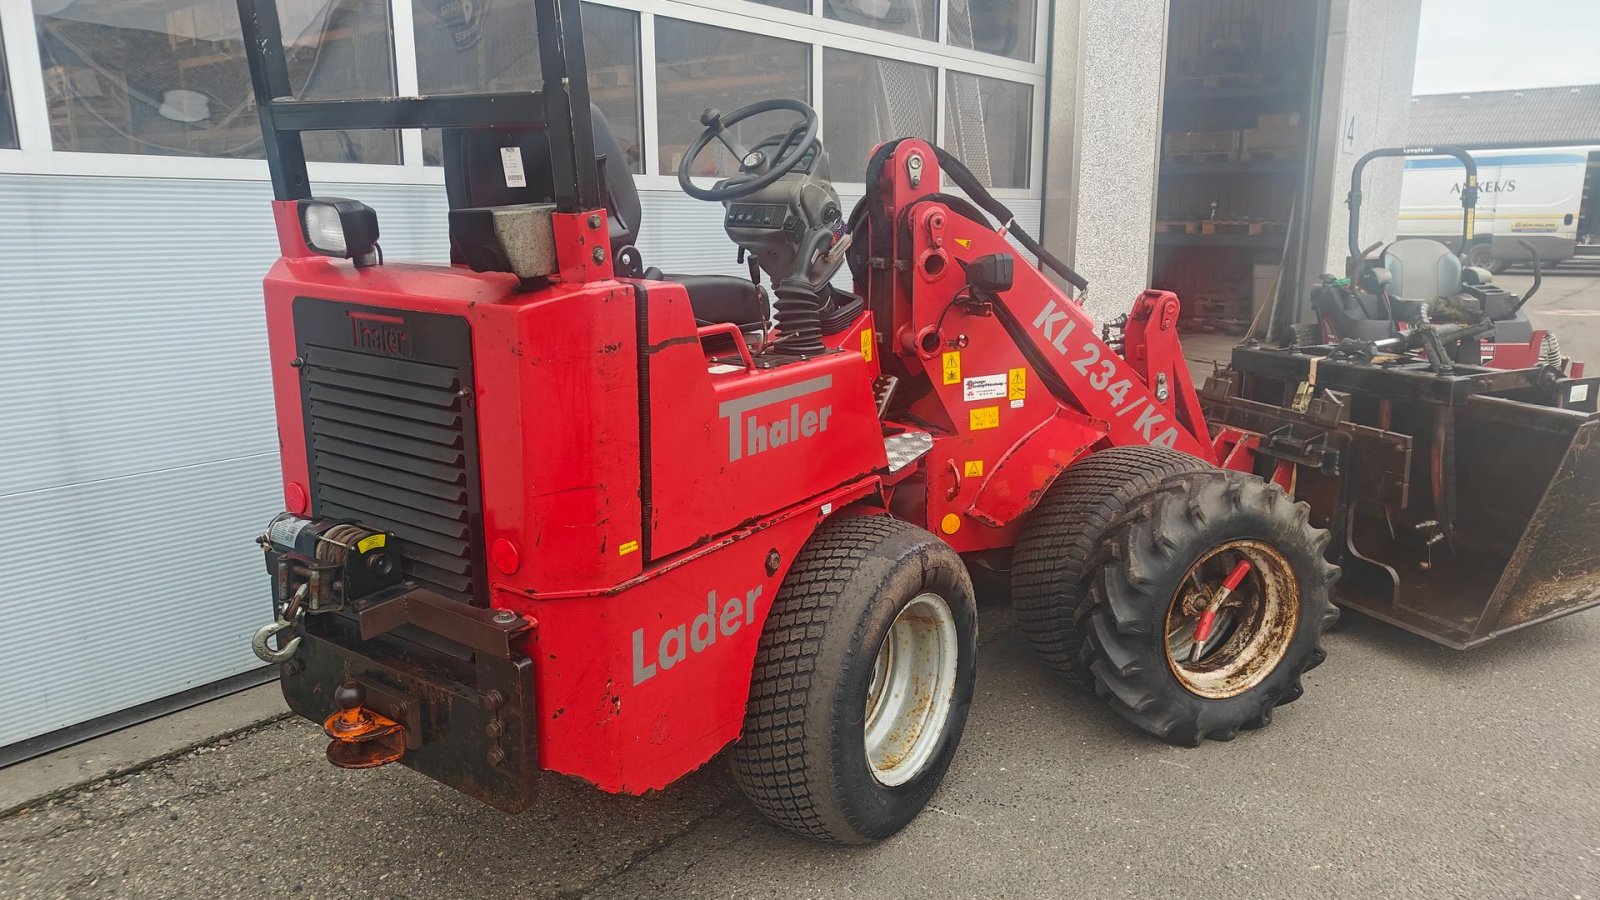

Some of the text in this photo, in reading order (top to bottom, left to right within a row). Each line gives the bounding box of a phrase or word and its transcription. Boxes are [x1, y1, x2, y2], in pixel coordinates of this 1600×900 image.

[345, 310, 408, 356] Thaler
[1033, 299, 1179, 451] KL 234/KA
[719, 373, 833, 464] Thaler
[632, 584, 763, 687] Lader
